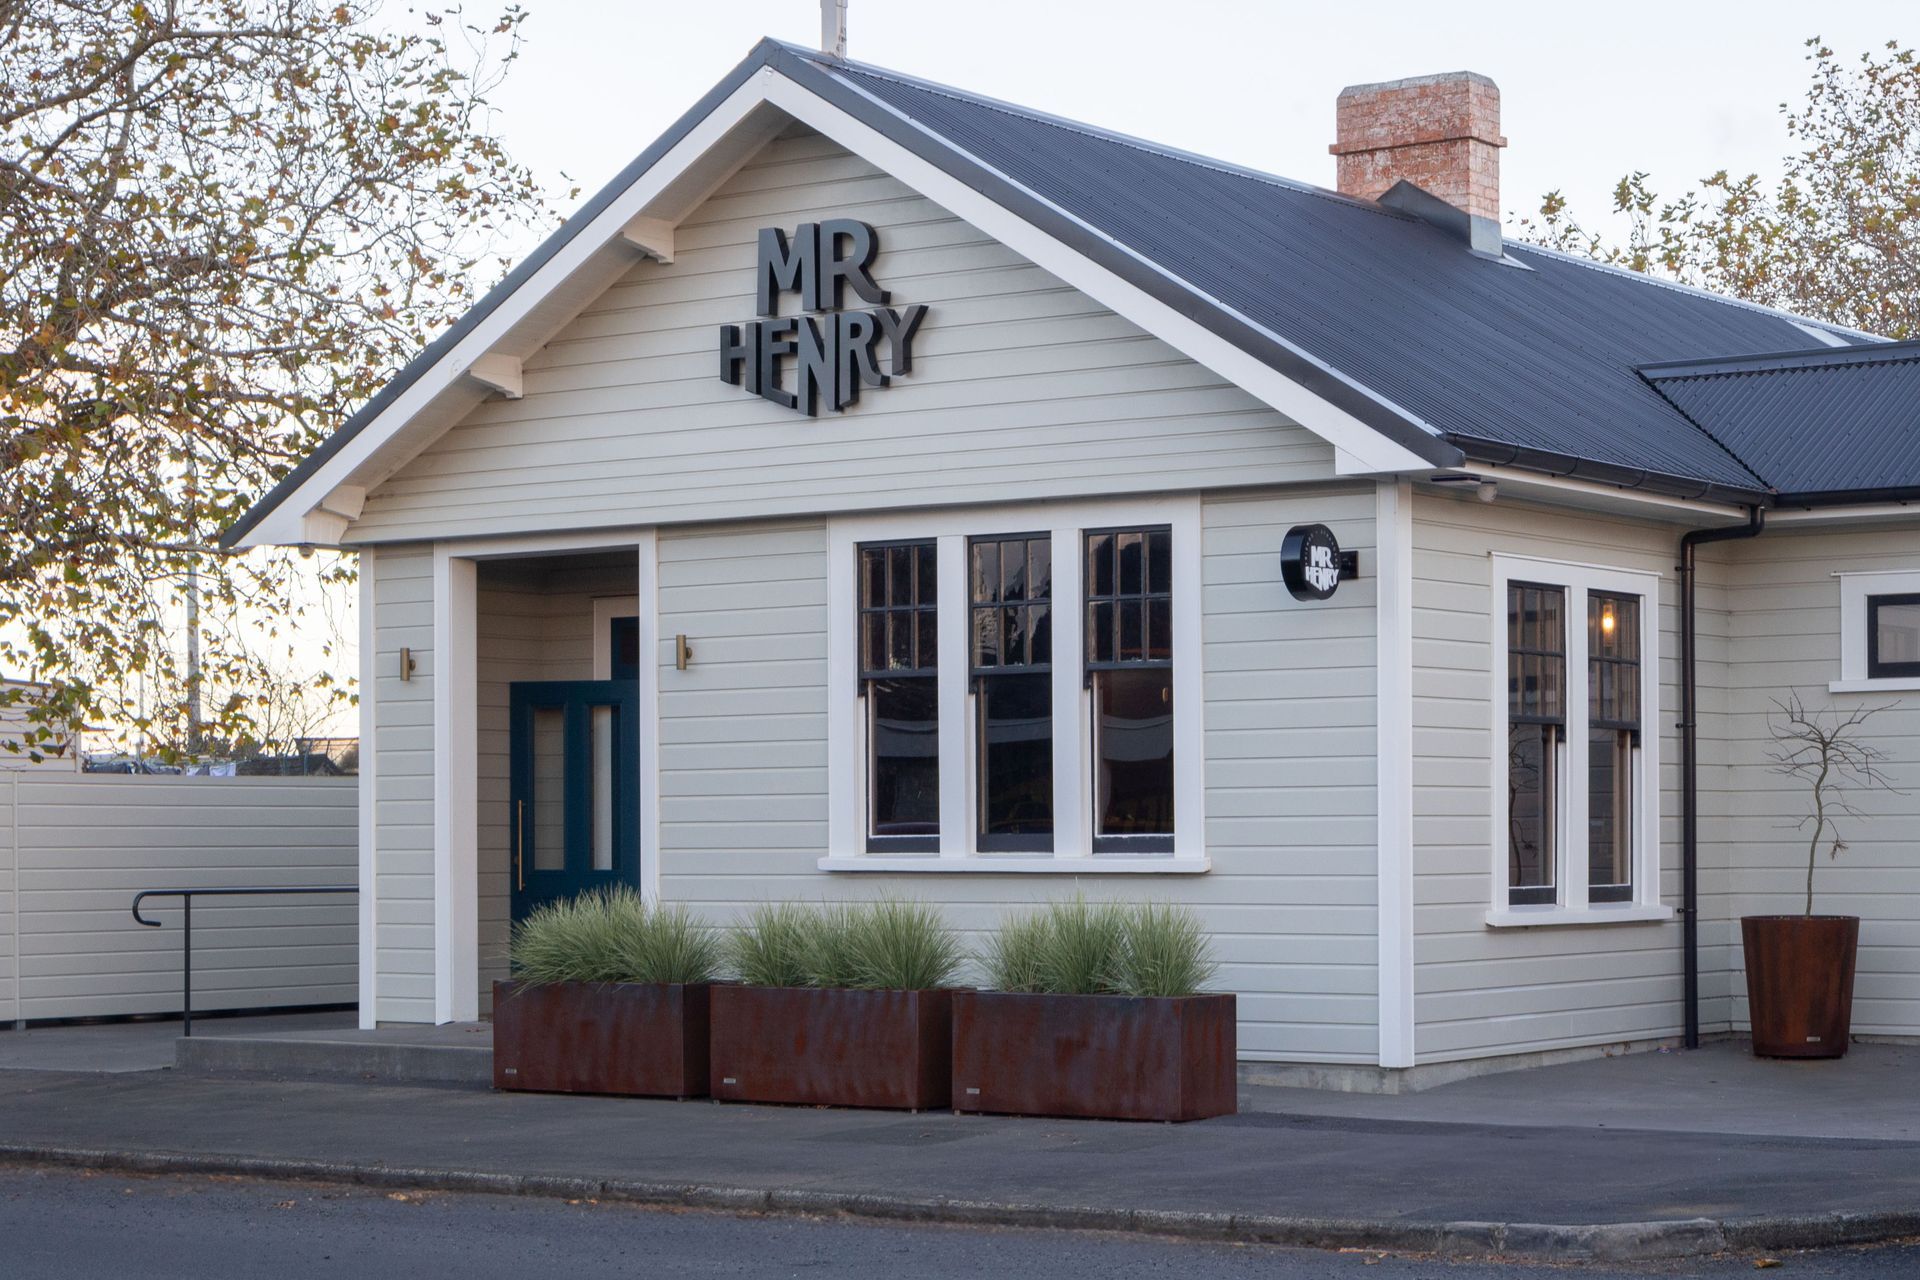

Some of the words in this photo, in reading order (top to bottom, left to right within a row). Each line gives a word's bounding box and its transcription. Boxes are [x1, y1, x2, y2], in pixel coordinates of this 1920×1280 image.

[757, 219, 891, 316] MR
[720, 305, 929, 417] HENRY
[1305, 566, 1339, 591] HENRY
[1310, 545, 1333, 568] MR
